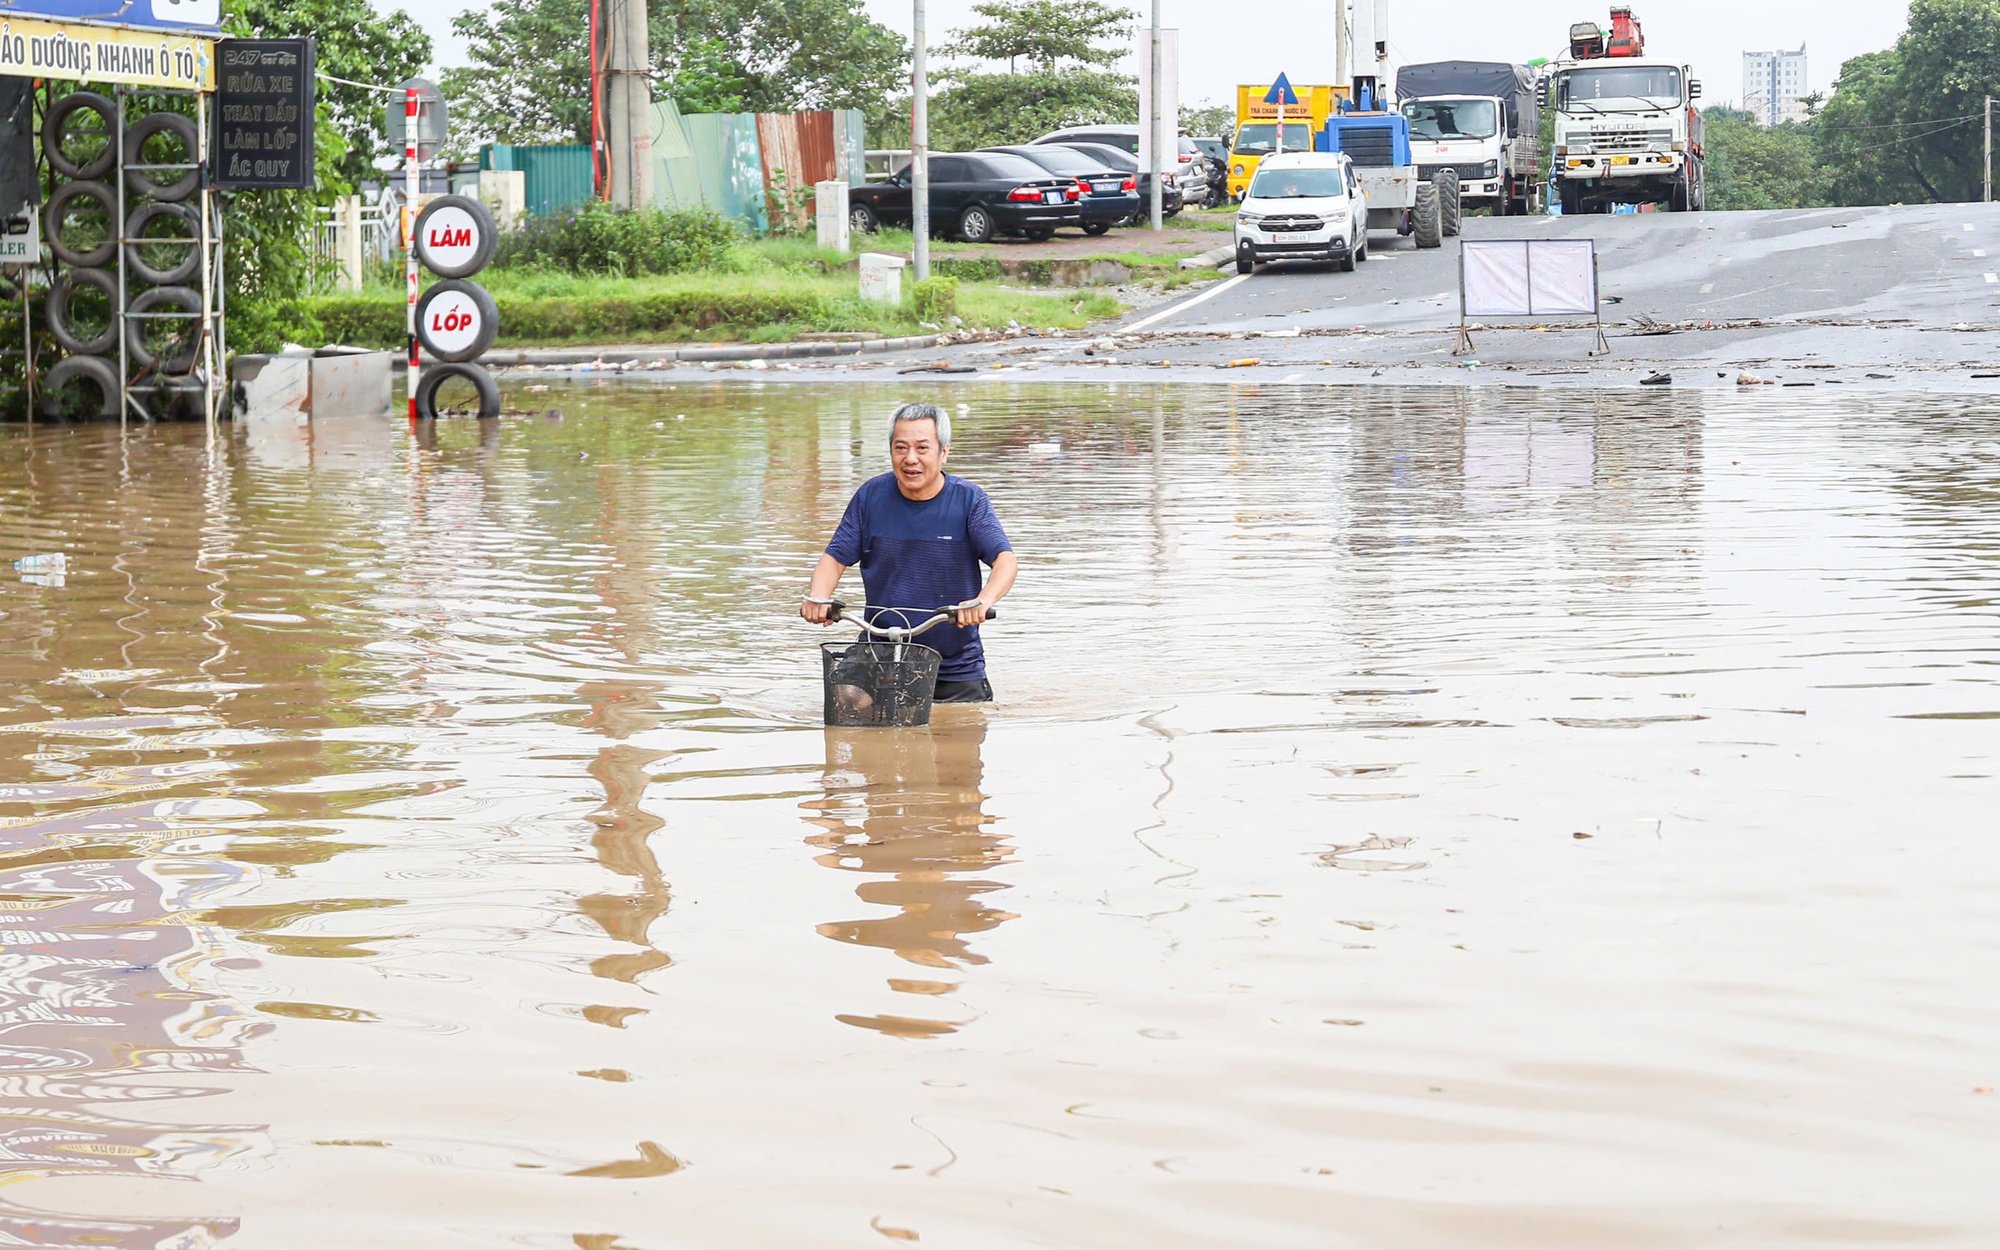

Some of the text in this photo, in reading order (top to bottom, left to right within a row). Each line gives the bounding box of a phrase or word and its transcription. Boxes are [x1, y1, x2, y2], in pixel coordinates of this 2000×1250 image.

[31, 32, 92, 71] DƯỠNG
[97, 43, 154, 76] NHANH
[159, 43, 170, 77] Ô
[174, 47, 194, 80] TÔ
[224, 50, 260, 66] 247
[227, 71, 293, 93] RỬA XE
[223, 105, 263, 122] THAY
[223, 126, 297, 150] LÀM LỐP
[1590, 123, 1646, 131] HYUNDAI
[228, 152, 290, 178] ẮC QUY
[429, 223, 471, 247] LÀM
[0, 242, 26, 255] LER
[432, 304, 472, 331] LỐP
